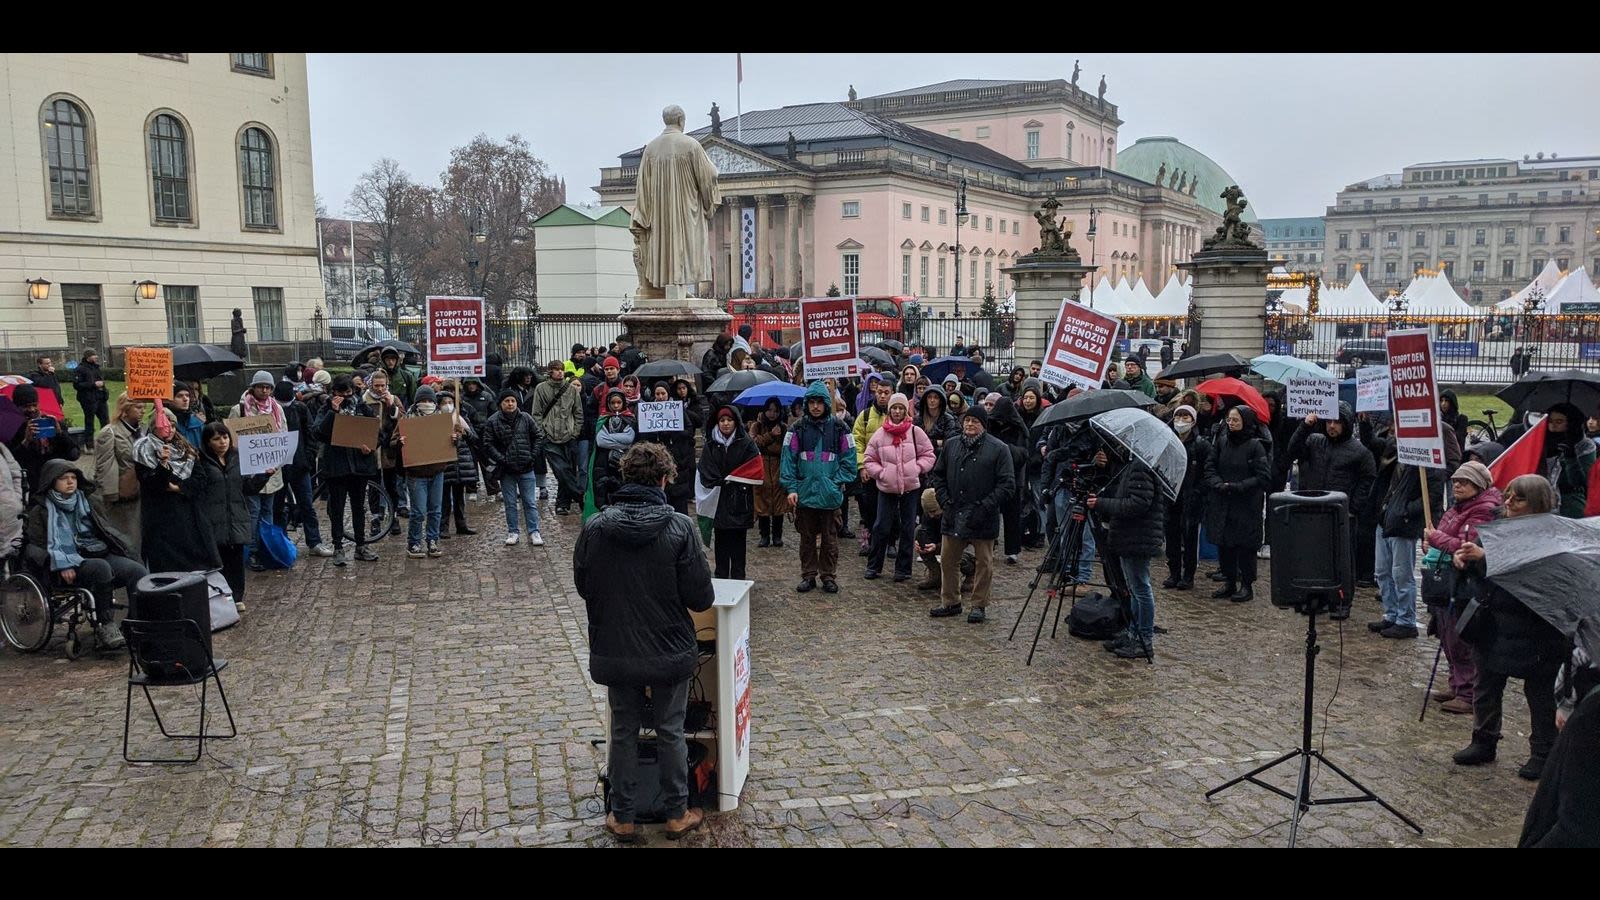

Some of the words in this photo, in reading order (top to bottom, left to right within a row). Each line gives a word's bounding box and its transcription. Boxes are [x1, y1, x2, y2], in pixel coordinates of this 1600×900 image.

[808, 311, 833, 320] STOPPT
[435, 318, 477, 326] GENOZID
[808, 318, 849, 329] GENOZID
[1067, 316, 1095, 330] STOPPT
[1095, 325, 1109, 335] DEN
[436, 329, 446, 337] IN
[450, 328, 477, 336] GAZA
[809, 331, 819, 340] IN
[822, 328, 850, 338] GAZA
[1064, 324, 1106, 345] GENOZID
[1061, 334, 1073, 344] IN
[1075, 339, 1102, 356] GAZA
[1391, 354, 1410, 365] STOPPT
[1412, 352, 1425, 363] DEN
[1393, 365, 1427, 381] GENOZID
[1290, 379, 1317, 387] Injustice
[1318, 380, 1335, 389] Any-
[133, 387, 166, 396] HUMAN
[1315, 389, 1335, 397] Threat
[1395, 385, 1402, 399] IN
[1404, 382, 1430, 397] GAZA
[1298, 397, 1322, 406] Justice
[641, 403, 663, 412] STAND
[1290, 406, 1329, 415] Everywhere
[648, 419, 679, 429] JUSTICE
[248, 436, 288, 449] SELECTIVE
[250, 449, 289, 466] EMPATHY
